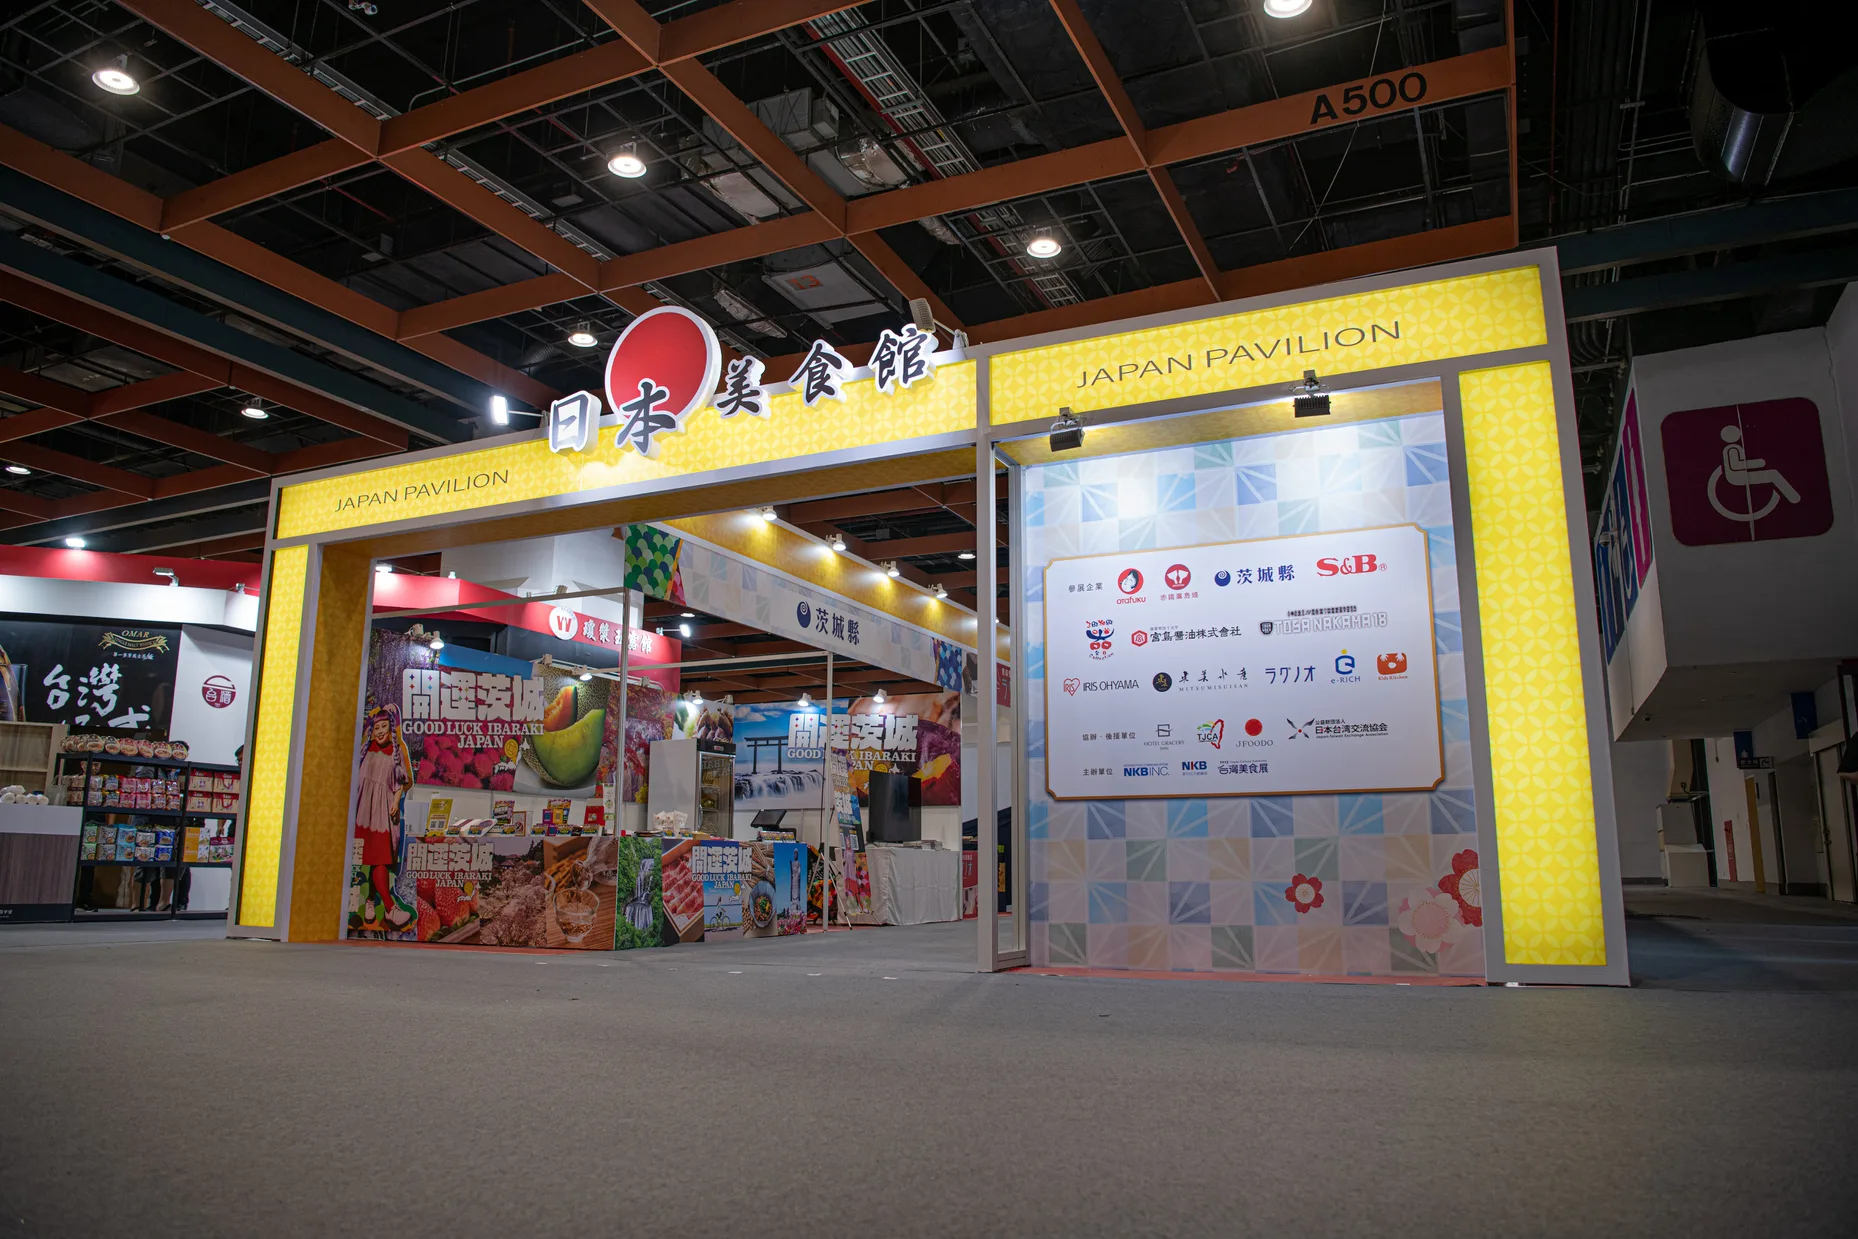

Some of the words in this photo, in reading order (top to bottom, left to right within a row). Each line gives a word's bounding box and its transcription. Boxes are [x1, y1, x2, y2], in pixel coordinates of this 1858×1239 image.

[1310, 71, 1428, 125] A500
[1077, 354, 1193, 388] JAPAN
[1206, 321, 1401, 368] PAVILION
[551, 327, 932, 454] 日本美食館
[335, 489, 398, 512] JAPAN
[404, 470, 509, 499] PAVILION
[1236, 564, 1295, 584] 茨城縣
[1273, 616, 1312, 635] TOSA
[1265, 665, 1316, 684] ラグノオ
[1330, 675, 1361, 684] e-RICH
[1083, 681, 1098, 691] IRIS
[1099, 679, 1140, 691] OHYAMA
[402, 721, 444, 734] GOOD
[446, 722, 483, 735] LUCK
[488, 723, 544, 735] IBARAKI
[457, 735, 504, 748] JAPAN
[1197, 733, 1218, 741] TJCA
[1236, 740, 1274, 748] JFOODO
[787, 749, 820, 759] GOOD
[861, 752, 916, 762] IBARAKI
[1182, 761, 1207, 771] NKB
[406, 871, 429, 880] GOOD
[430, 872, 451, 880] LUCK
[454, 872, 493, 881] IBARAKI
[435, 880, 464, 888] JAPAN
